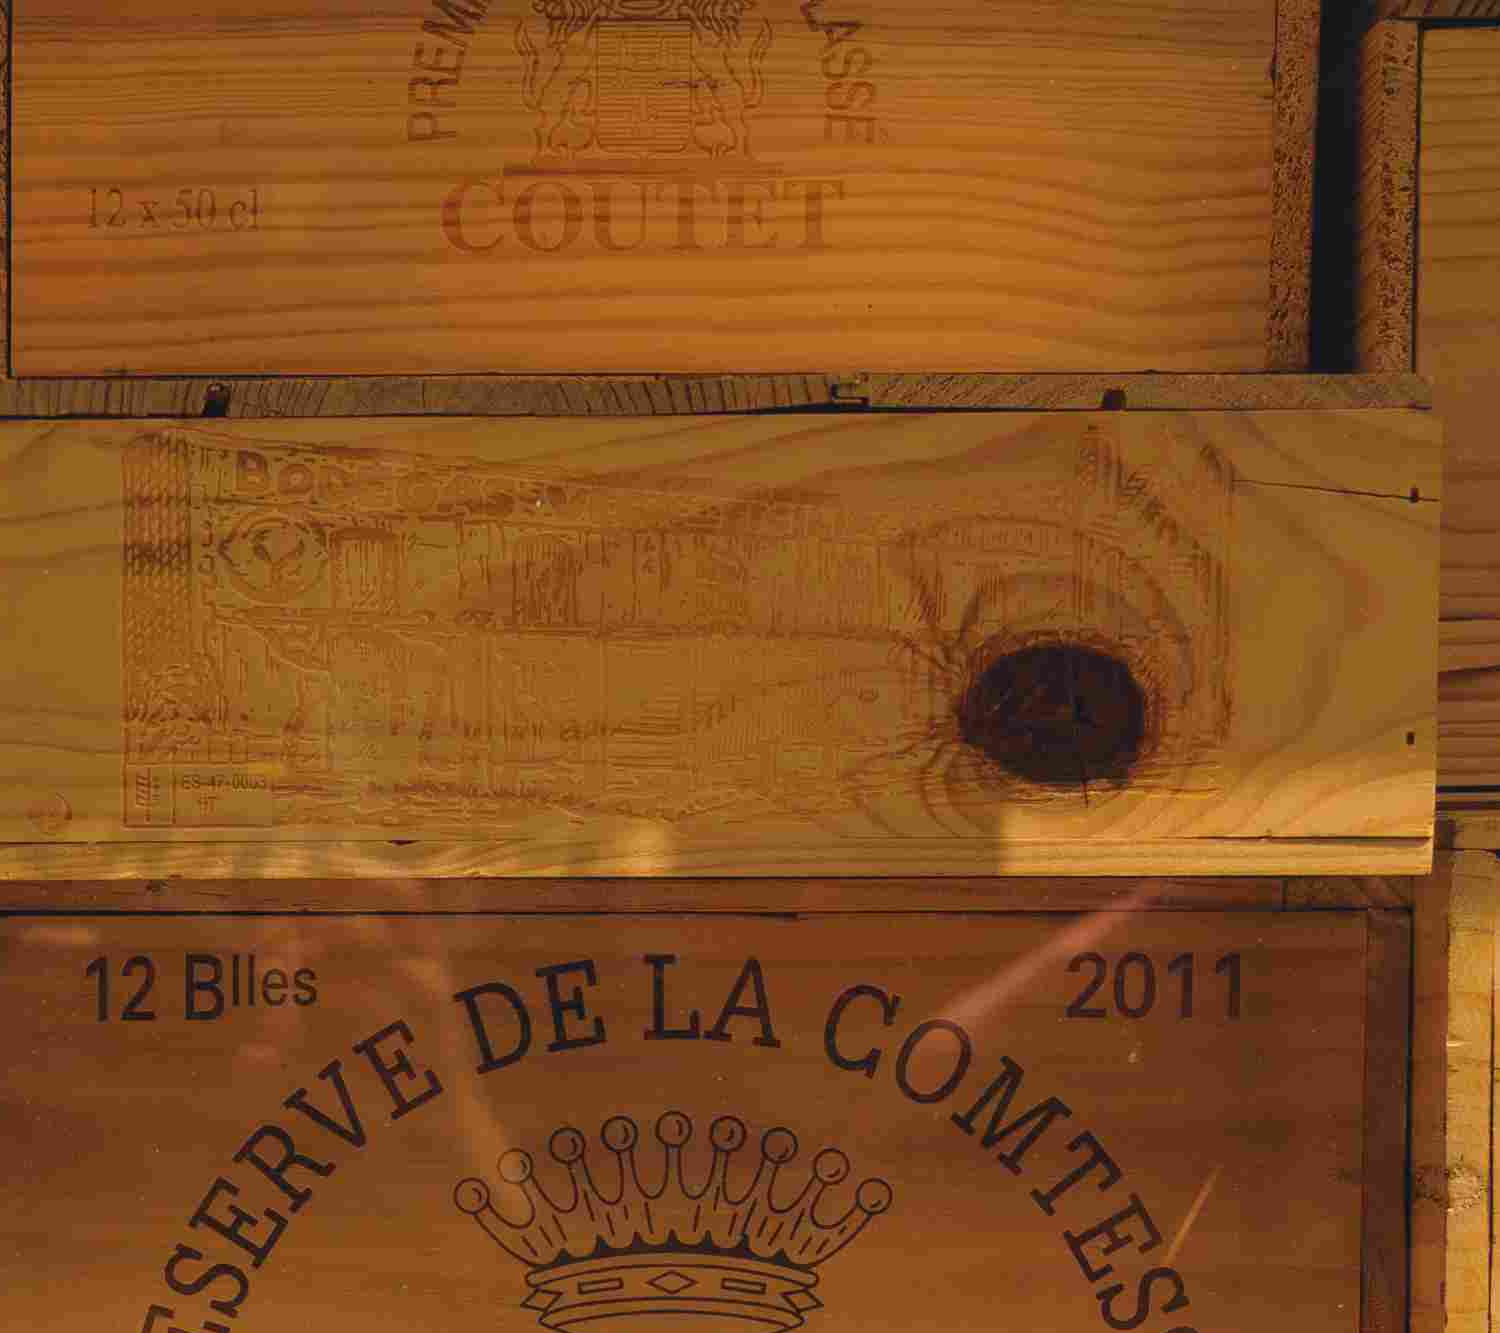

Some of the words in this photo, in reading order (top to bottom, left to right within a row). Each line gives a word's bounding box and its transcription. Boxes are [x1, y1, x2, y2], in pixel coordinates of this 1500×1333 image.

[88, 186, 127, 230] 12
[440, 178, 846, 256] COUTET
[84, 955, 158, 1022] 12
[453, 958, 607, 1075] DE
[641, 951, 783, 1050] LA
[1063, 951, 1249, 1021] 2011
